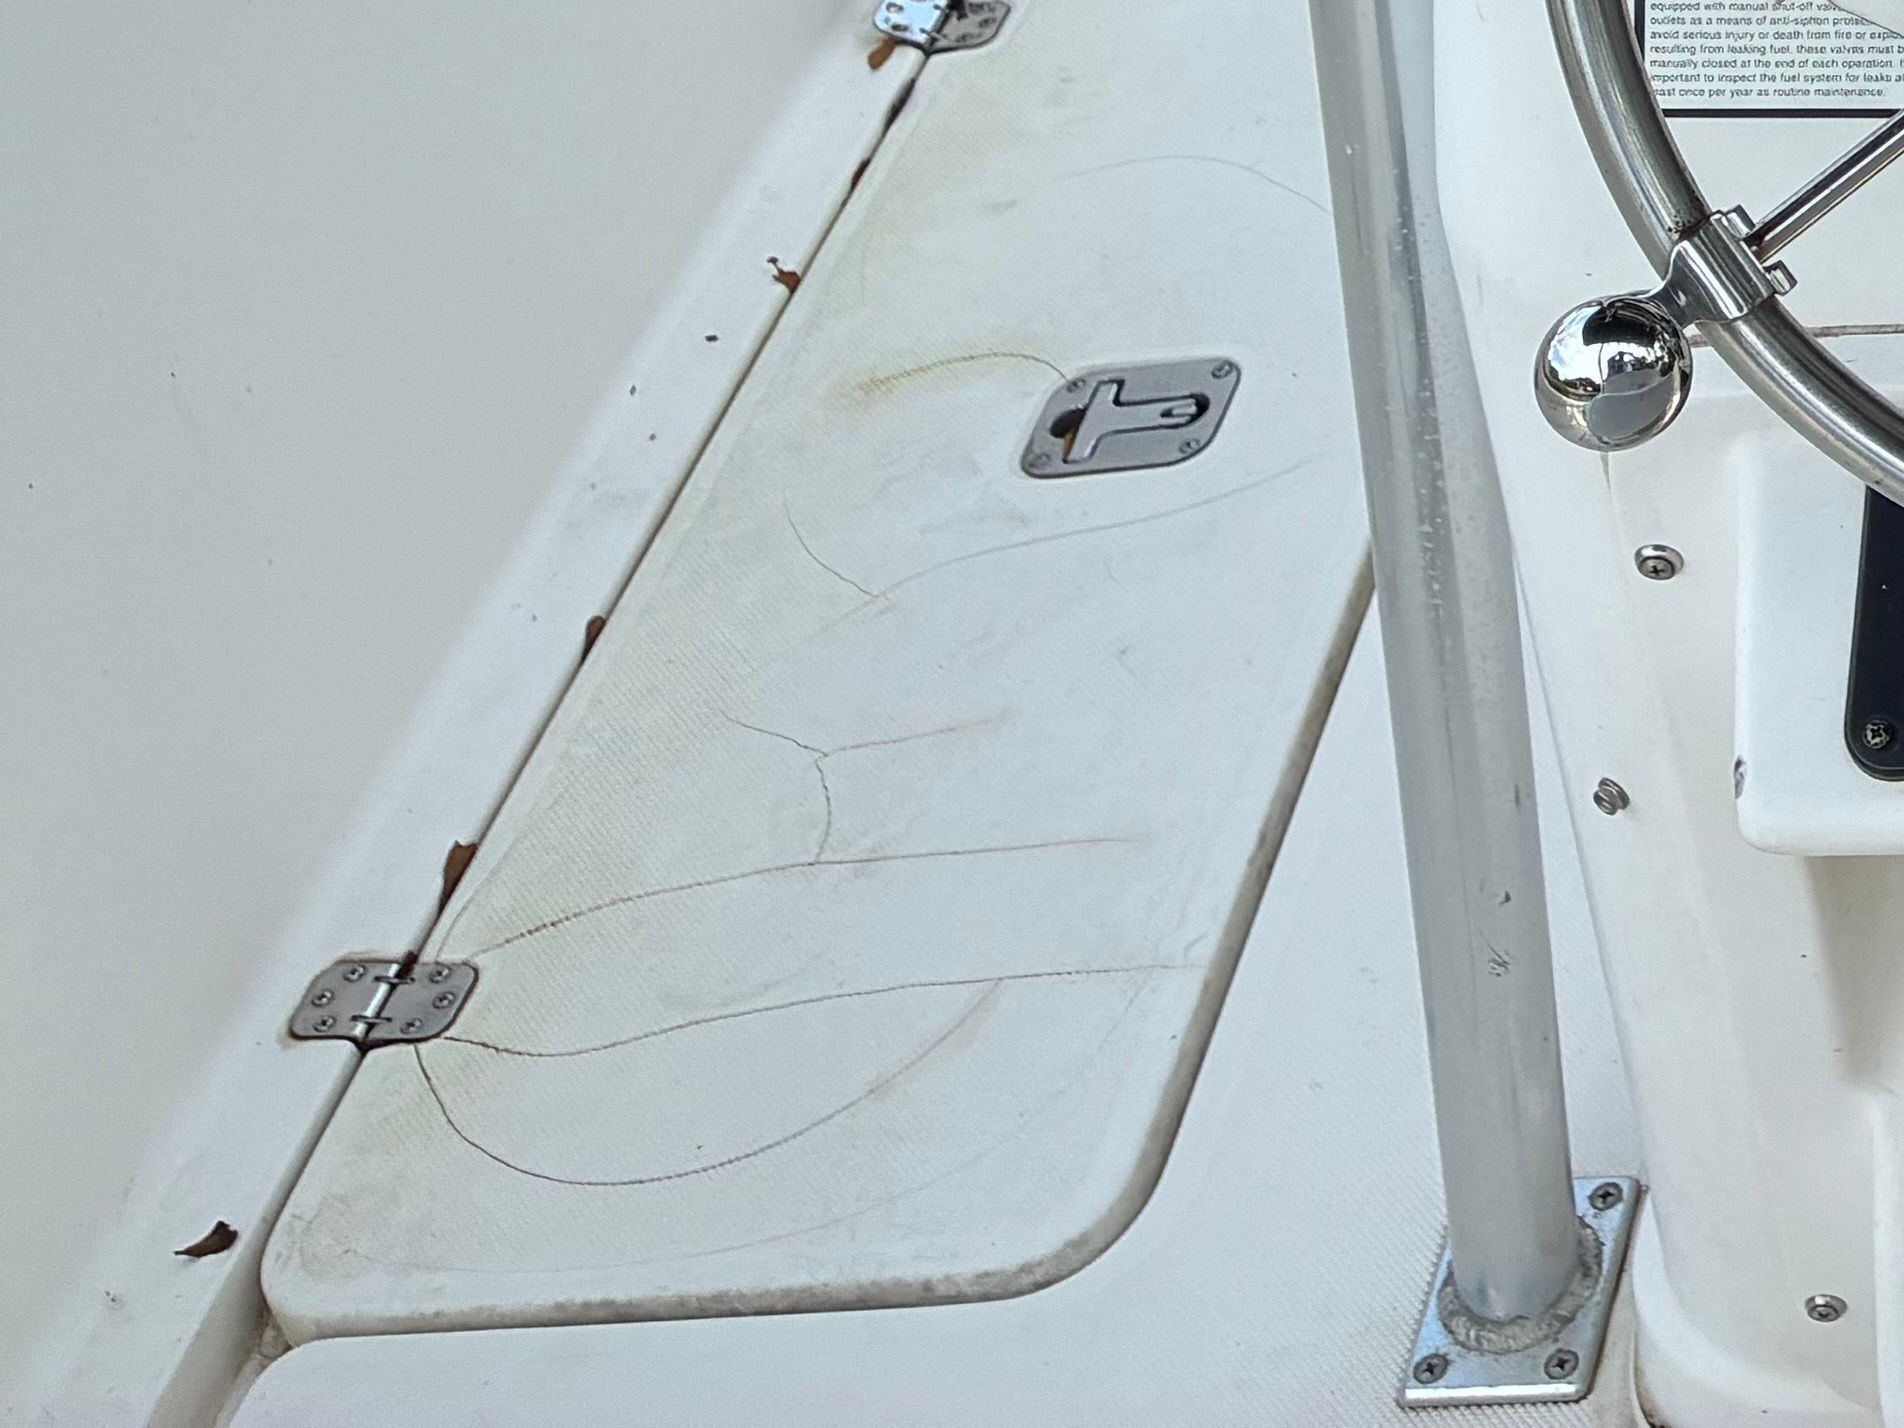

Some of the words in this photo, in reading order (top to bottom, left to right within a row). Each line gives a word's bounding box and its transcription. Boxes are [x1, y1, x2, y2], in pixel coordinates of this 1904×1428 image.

[1650, 2, 1701, 13] equipped
[1729, 1, 1768, 11] manual
[1716, 17, 1753, 25] means
[1772, 30, 1804, 40] death
[1807, 30, 1831, 40] from
[1650, 44, 1696, 56] resulting
[1700, 44, 1725, 54] from
[1867, 45, 1894, 54] must
[1701, 59, 1738, 68] closed
[1754, 59, 1771, 68] the
[1759, 73, 1777, 82] the
[1780, 73, 1800, 82] fuel
